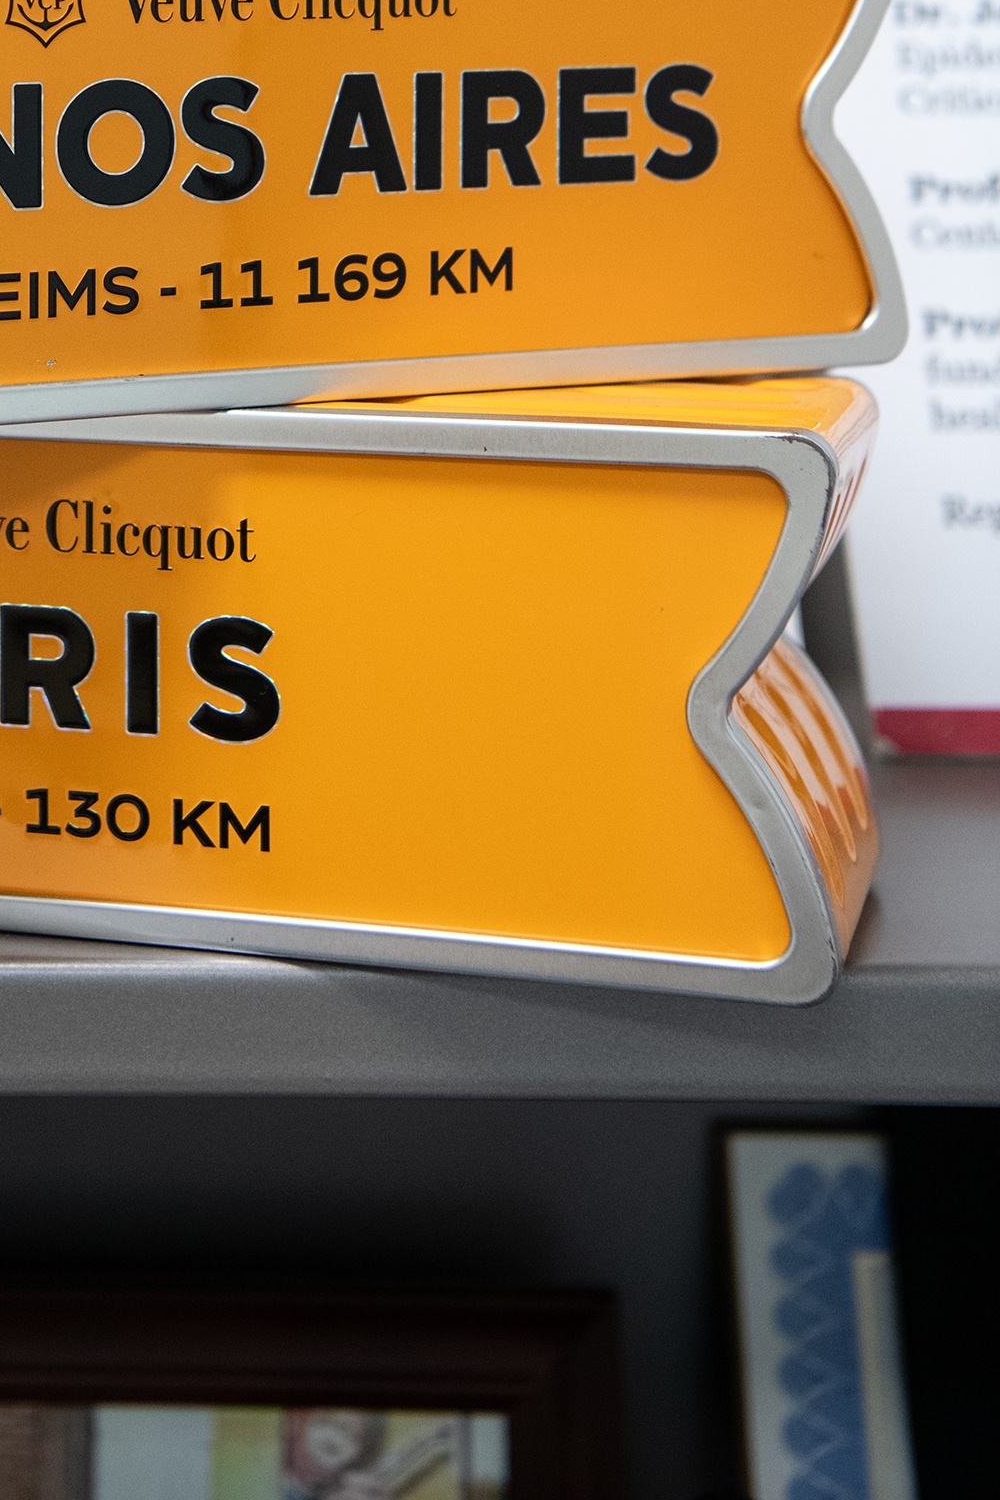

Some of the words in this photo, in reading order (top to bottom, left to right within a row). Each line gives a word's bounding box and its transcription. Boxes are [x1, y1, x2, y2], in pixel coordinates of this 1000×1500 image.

[309, 64, 719, 196] AIRES
[200, 259, 274, 310] 11
[297, 252, 407, 304] 169
[430, 246, 513, 296] KM
[45, 498, 257, 572] Clicquot
[25, 788, 150, 842] 130
[172, 798, 271, 853] KM
